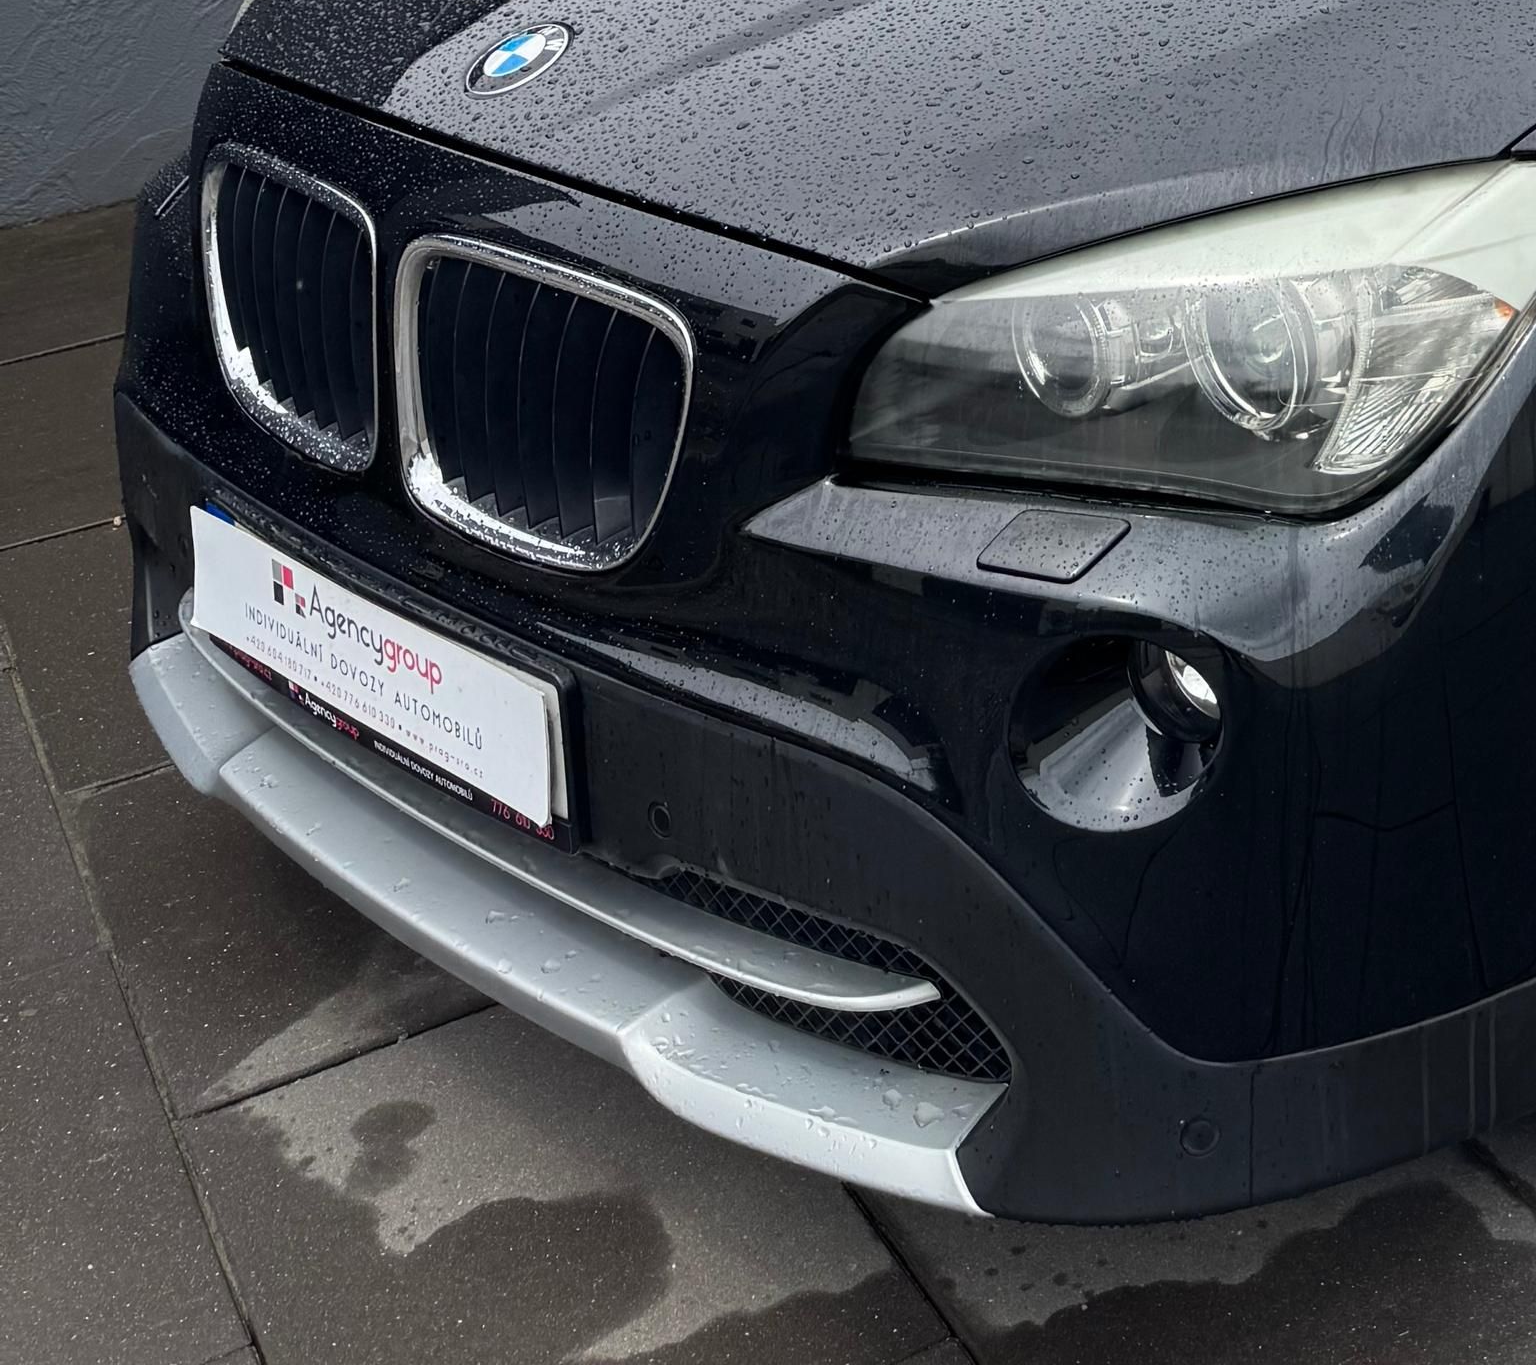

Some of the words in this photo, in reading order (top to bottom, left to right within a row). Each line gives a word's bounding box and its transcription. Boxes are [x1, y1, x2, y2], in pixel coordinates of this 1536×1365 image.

[245, 603, 323, 663] INDIVIDUÁLNÍ
[331, 653, 384, 697] DOVOZY
[395, 690, 483, 750] AUTOMOBILŮ
[309, 584, 443, 695] Agencygroup
[491, 798, 511, 820] 776
